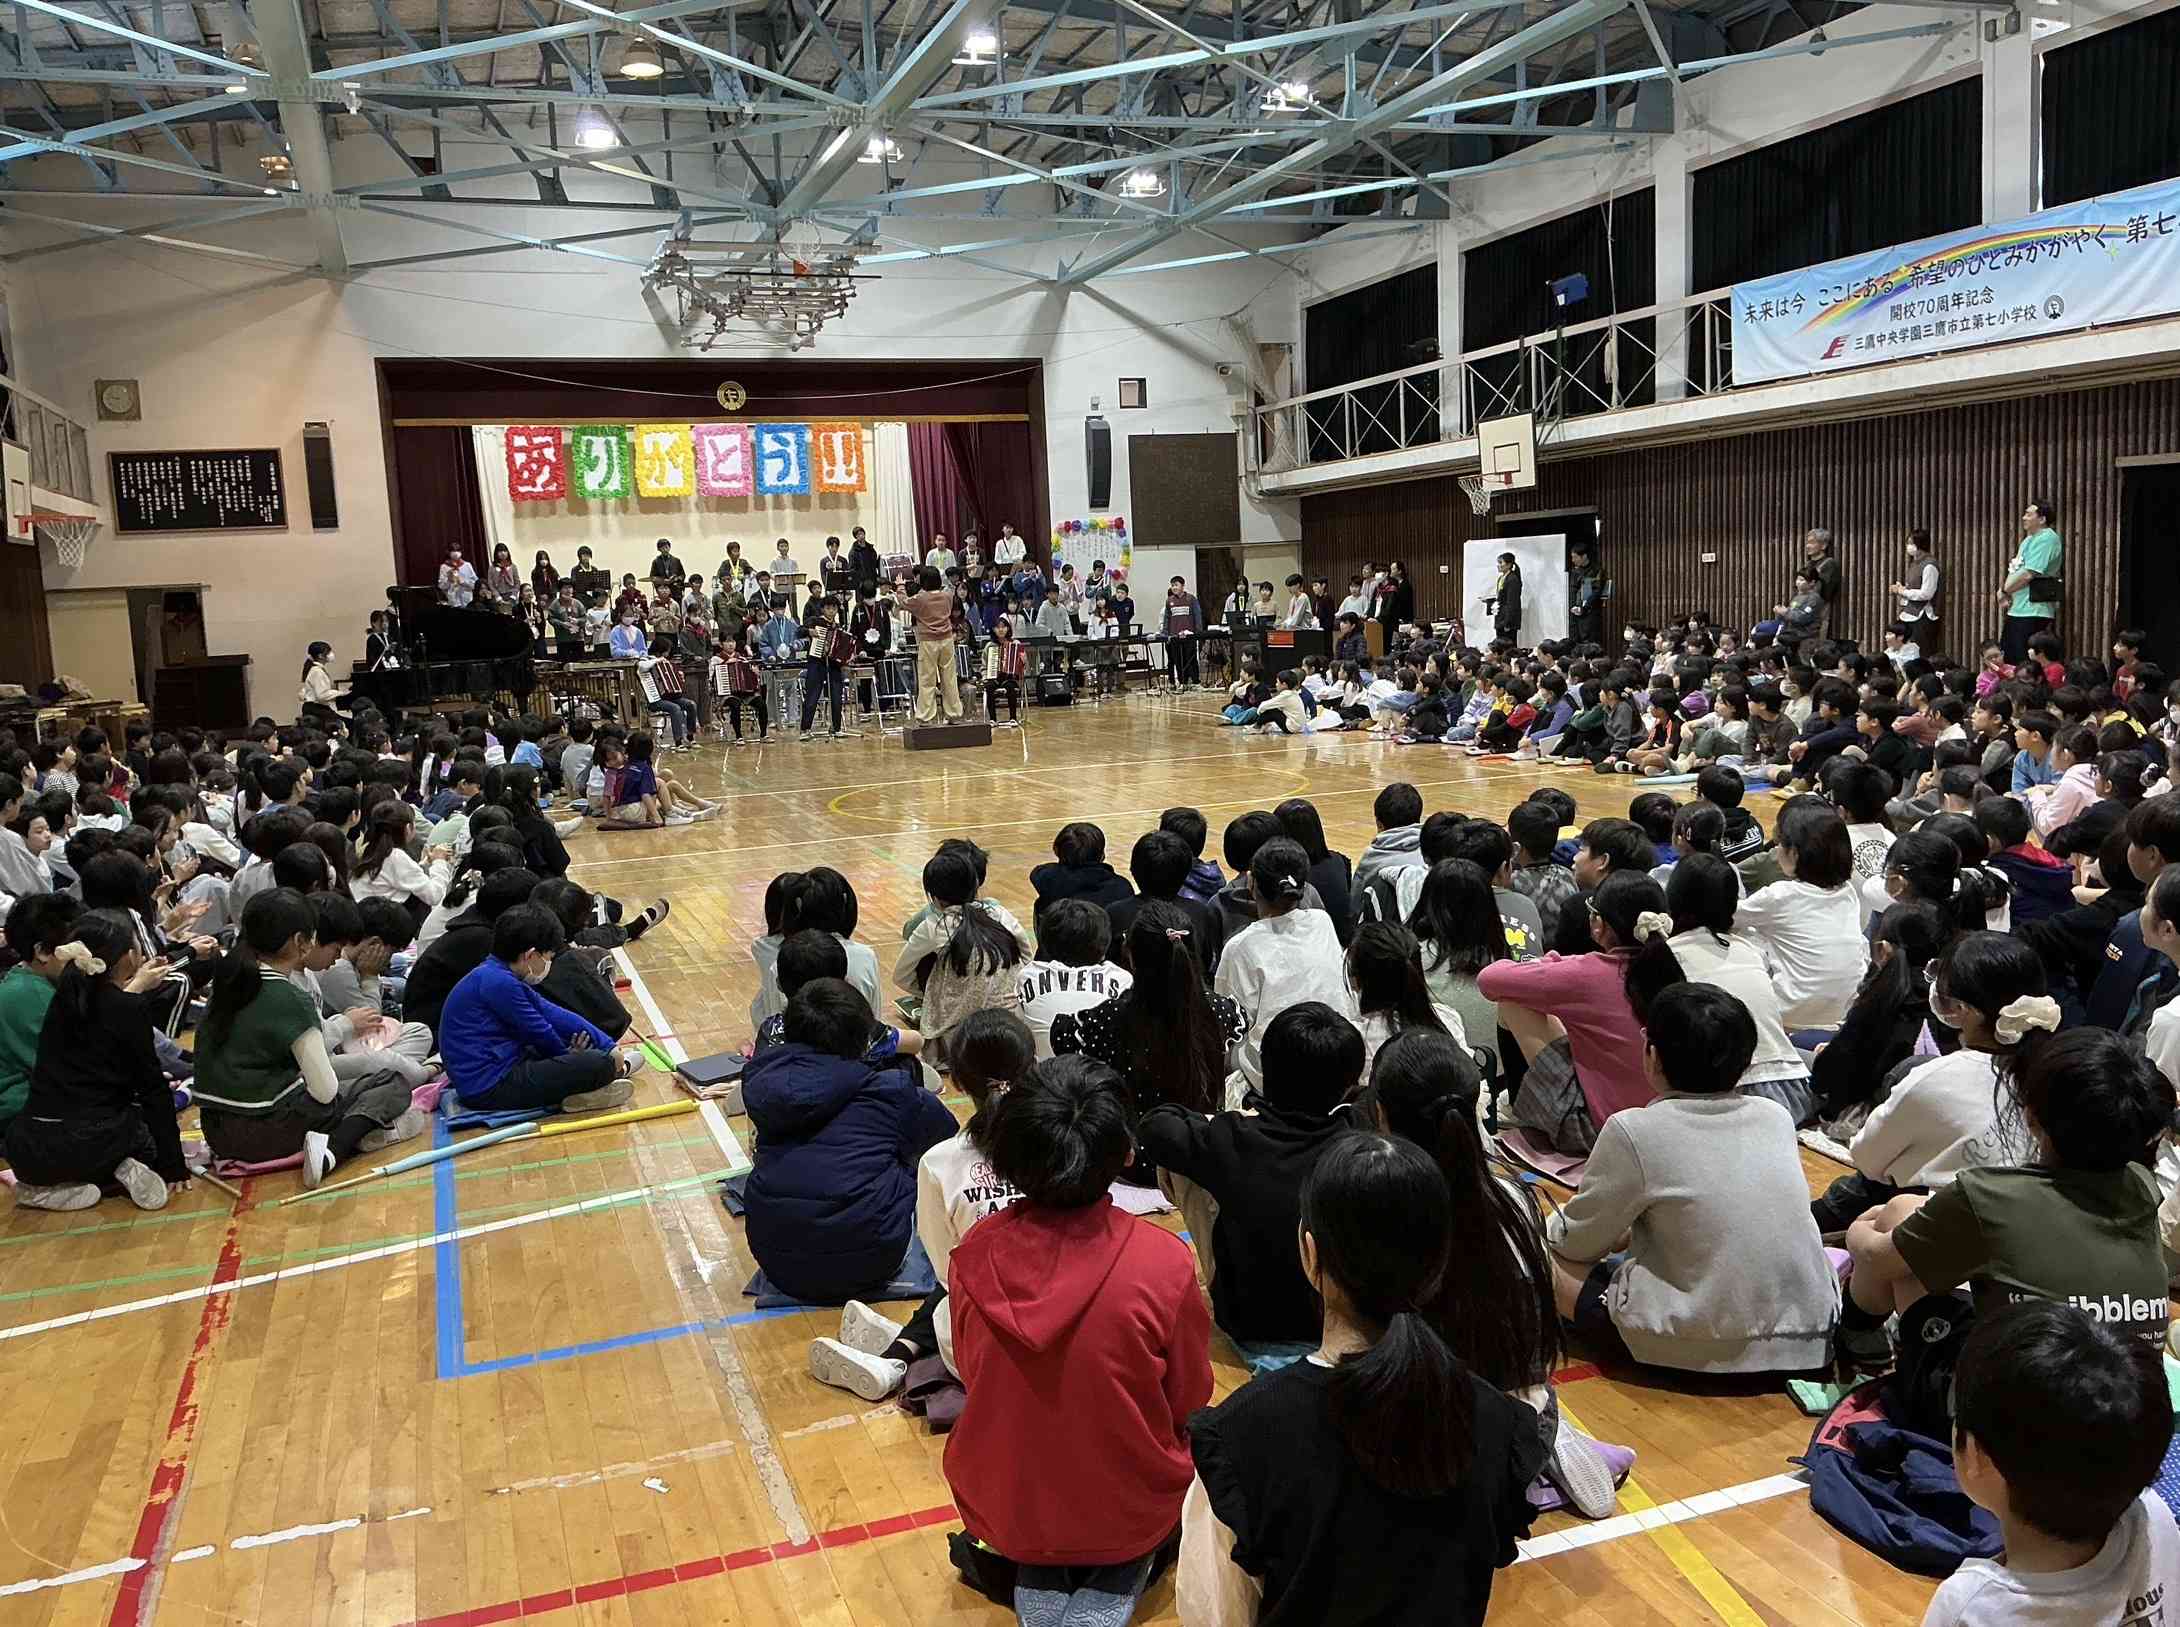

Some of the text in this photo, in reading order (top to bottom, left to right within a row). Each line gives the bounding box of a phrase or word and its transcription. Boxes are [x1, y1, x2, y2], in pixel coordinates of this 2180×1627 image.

[1744, 292, 1806, 324] 未来は今
[1818, 273, 1893, 306] ここにある
[2126, 211, 2180, 243] 第七
[1890, 286, 1994, 321] 開校70周年記念
[1018, 968, 1120, 1003] ONVERS
